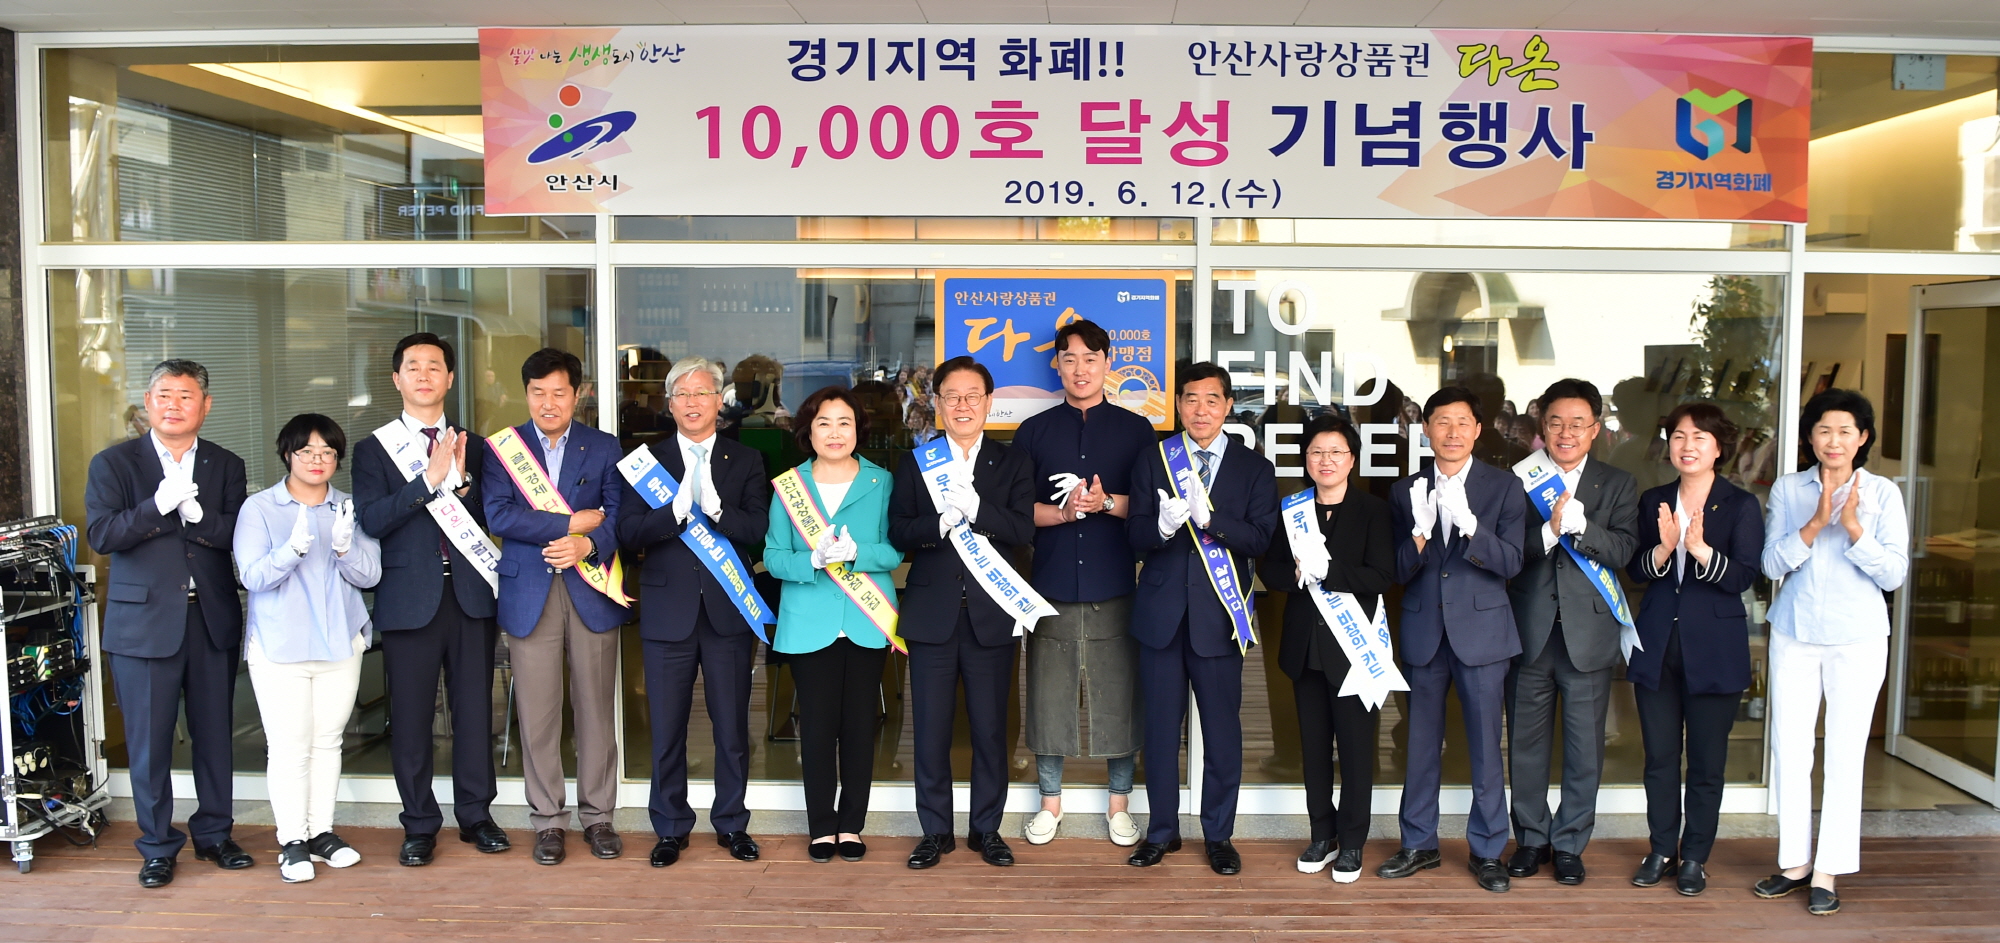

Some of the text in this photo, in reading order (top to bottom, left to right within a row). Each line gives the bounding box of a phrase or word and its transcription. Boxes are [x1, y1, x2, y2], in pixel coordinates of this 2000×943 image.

[509, 46, 537, 66] 살맛
[540, 49, 563, 64] 나는
[787, 34, 1560, 93] 경기지역 화폐!! 안산사랑상품권 다온
[696, 98, 1594, 169] 10,000호 달성 기념행사
[545, 173, 619, 192] 안산시
[1004, 180, 1095, 208] 2019.
[1116, 180, 1148, 208] 6.
[1656, 171, 1772, 192] 경기지역화폐
[954, 291, 1057, 306] 안산사랑상품권
[1217, 279, 1318, 336] TO
[1104, 329, 1152, 342] 0,000호
[1217, 350, 1389, 406] FIND
[510, 452, 548, 496] 골목경제
[647, 477, 673, 503] 우리
[720, 558, 747, 596] 비장의
[743, 592, 762, 621] 카드
[779, 476, 822, 537] 안산사랑상품권
[860, 591, 881, 611] 모집
[986, 567, 1020, 600] 비장의
[1015, 597, 1037, 615] 카드
[1336, 609, 1368, 651] 비장의
[1360, 650, 1386, 679] 카드
